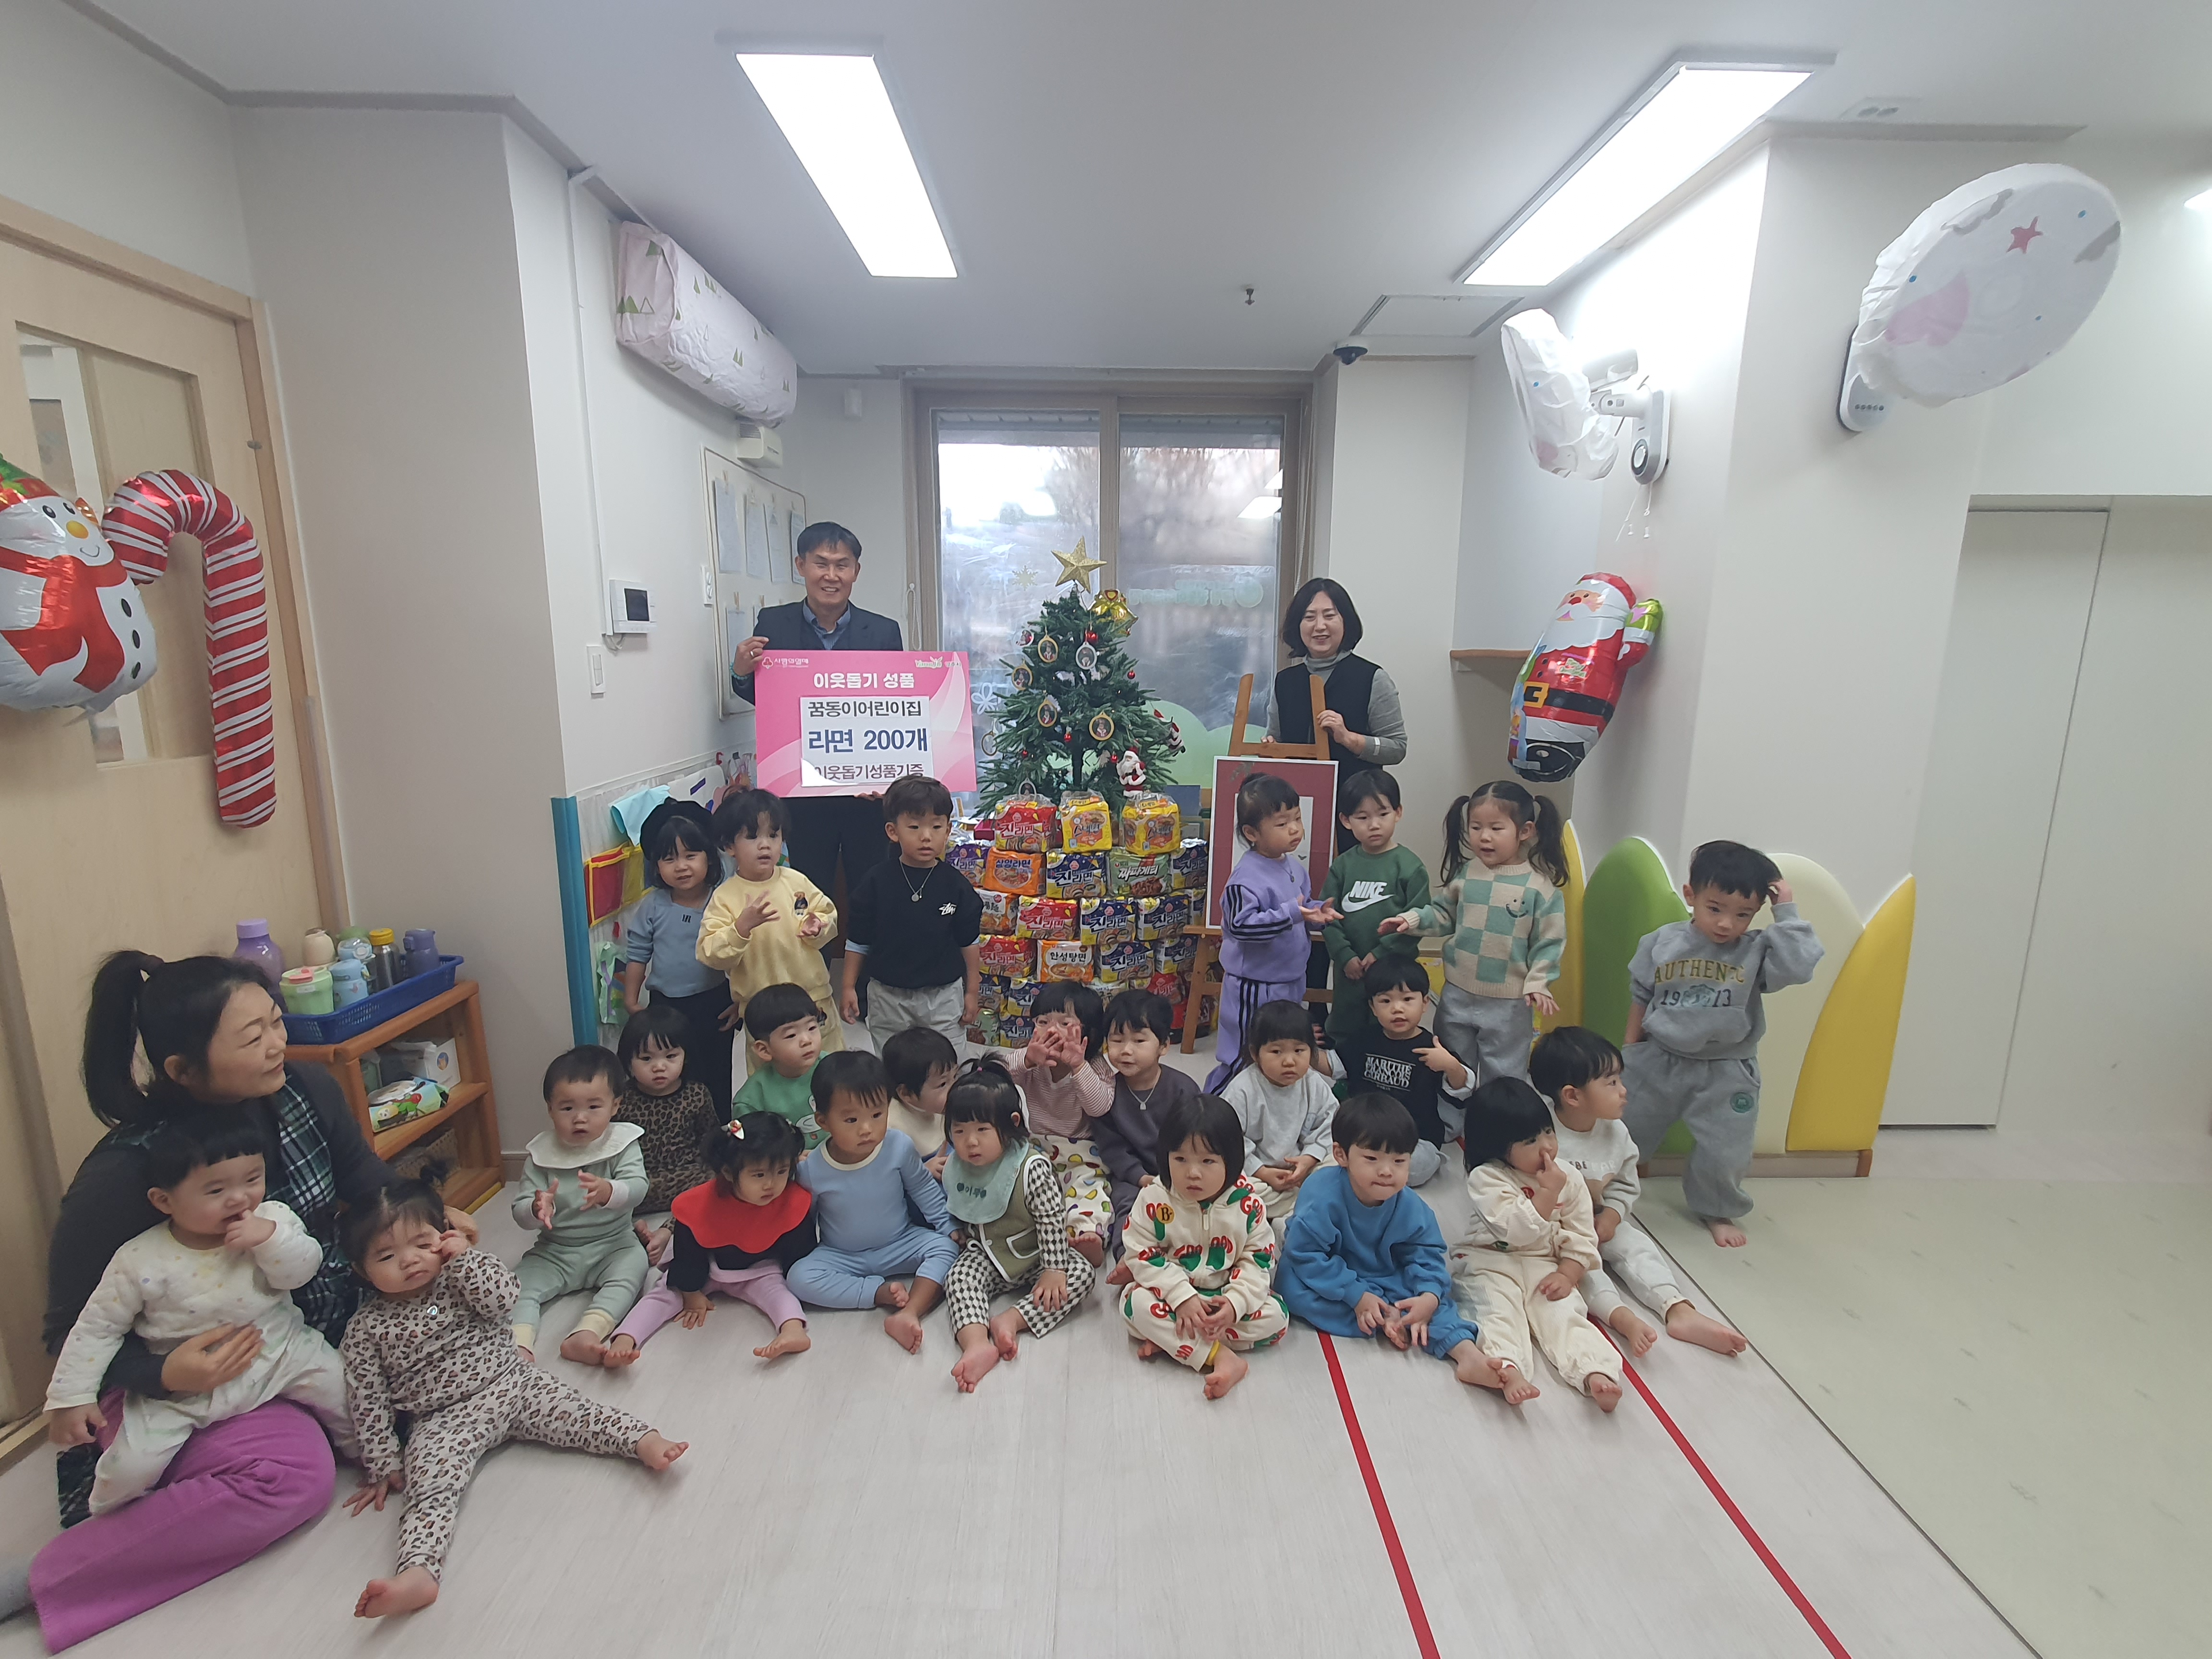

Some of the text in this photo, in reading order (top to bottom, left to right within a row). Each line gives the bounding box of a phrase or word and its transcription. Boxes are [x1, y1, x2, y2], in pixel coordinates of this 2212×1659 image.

[814, 673, 914, 689] 이웃돕기 성품
[808, 701, 921, 718] 꿈동이어린이집
[808, 728, 927, 754] 라면 200개
[1055, 869, 1093, 887] 진라면
[1118, 865, 1159, 881] 짜파게티
[1349, 881, 1387, 899] NIKE
[1089, 916, 1127, 933] 진라면
[1050, 952, 1087, 962] 안성탕면
[1364, 1070, 1409, 1088] GIRBAUD
